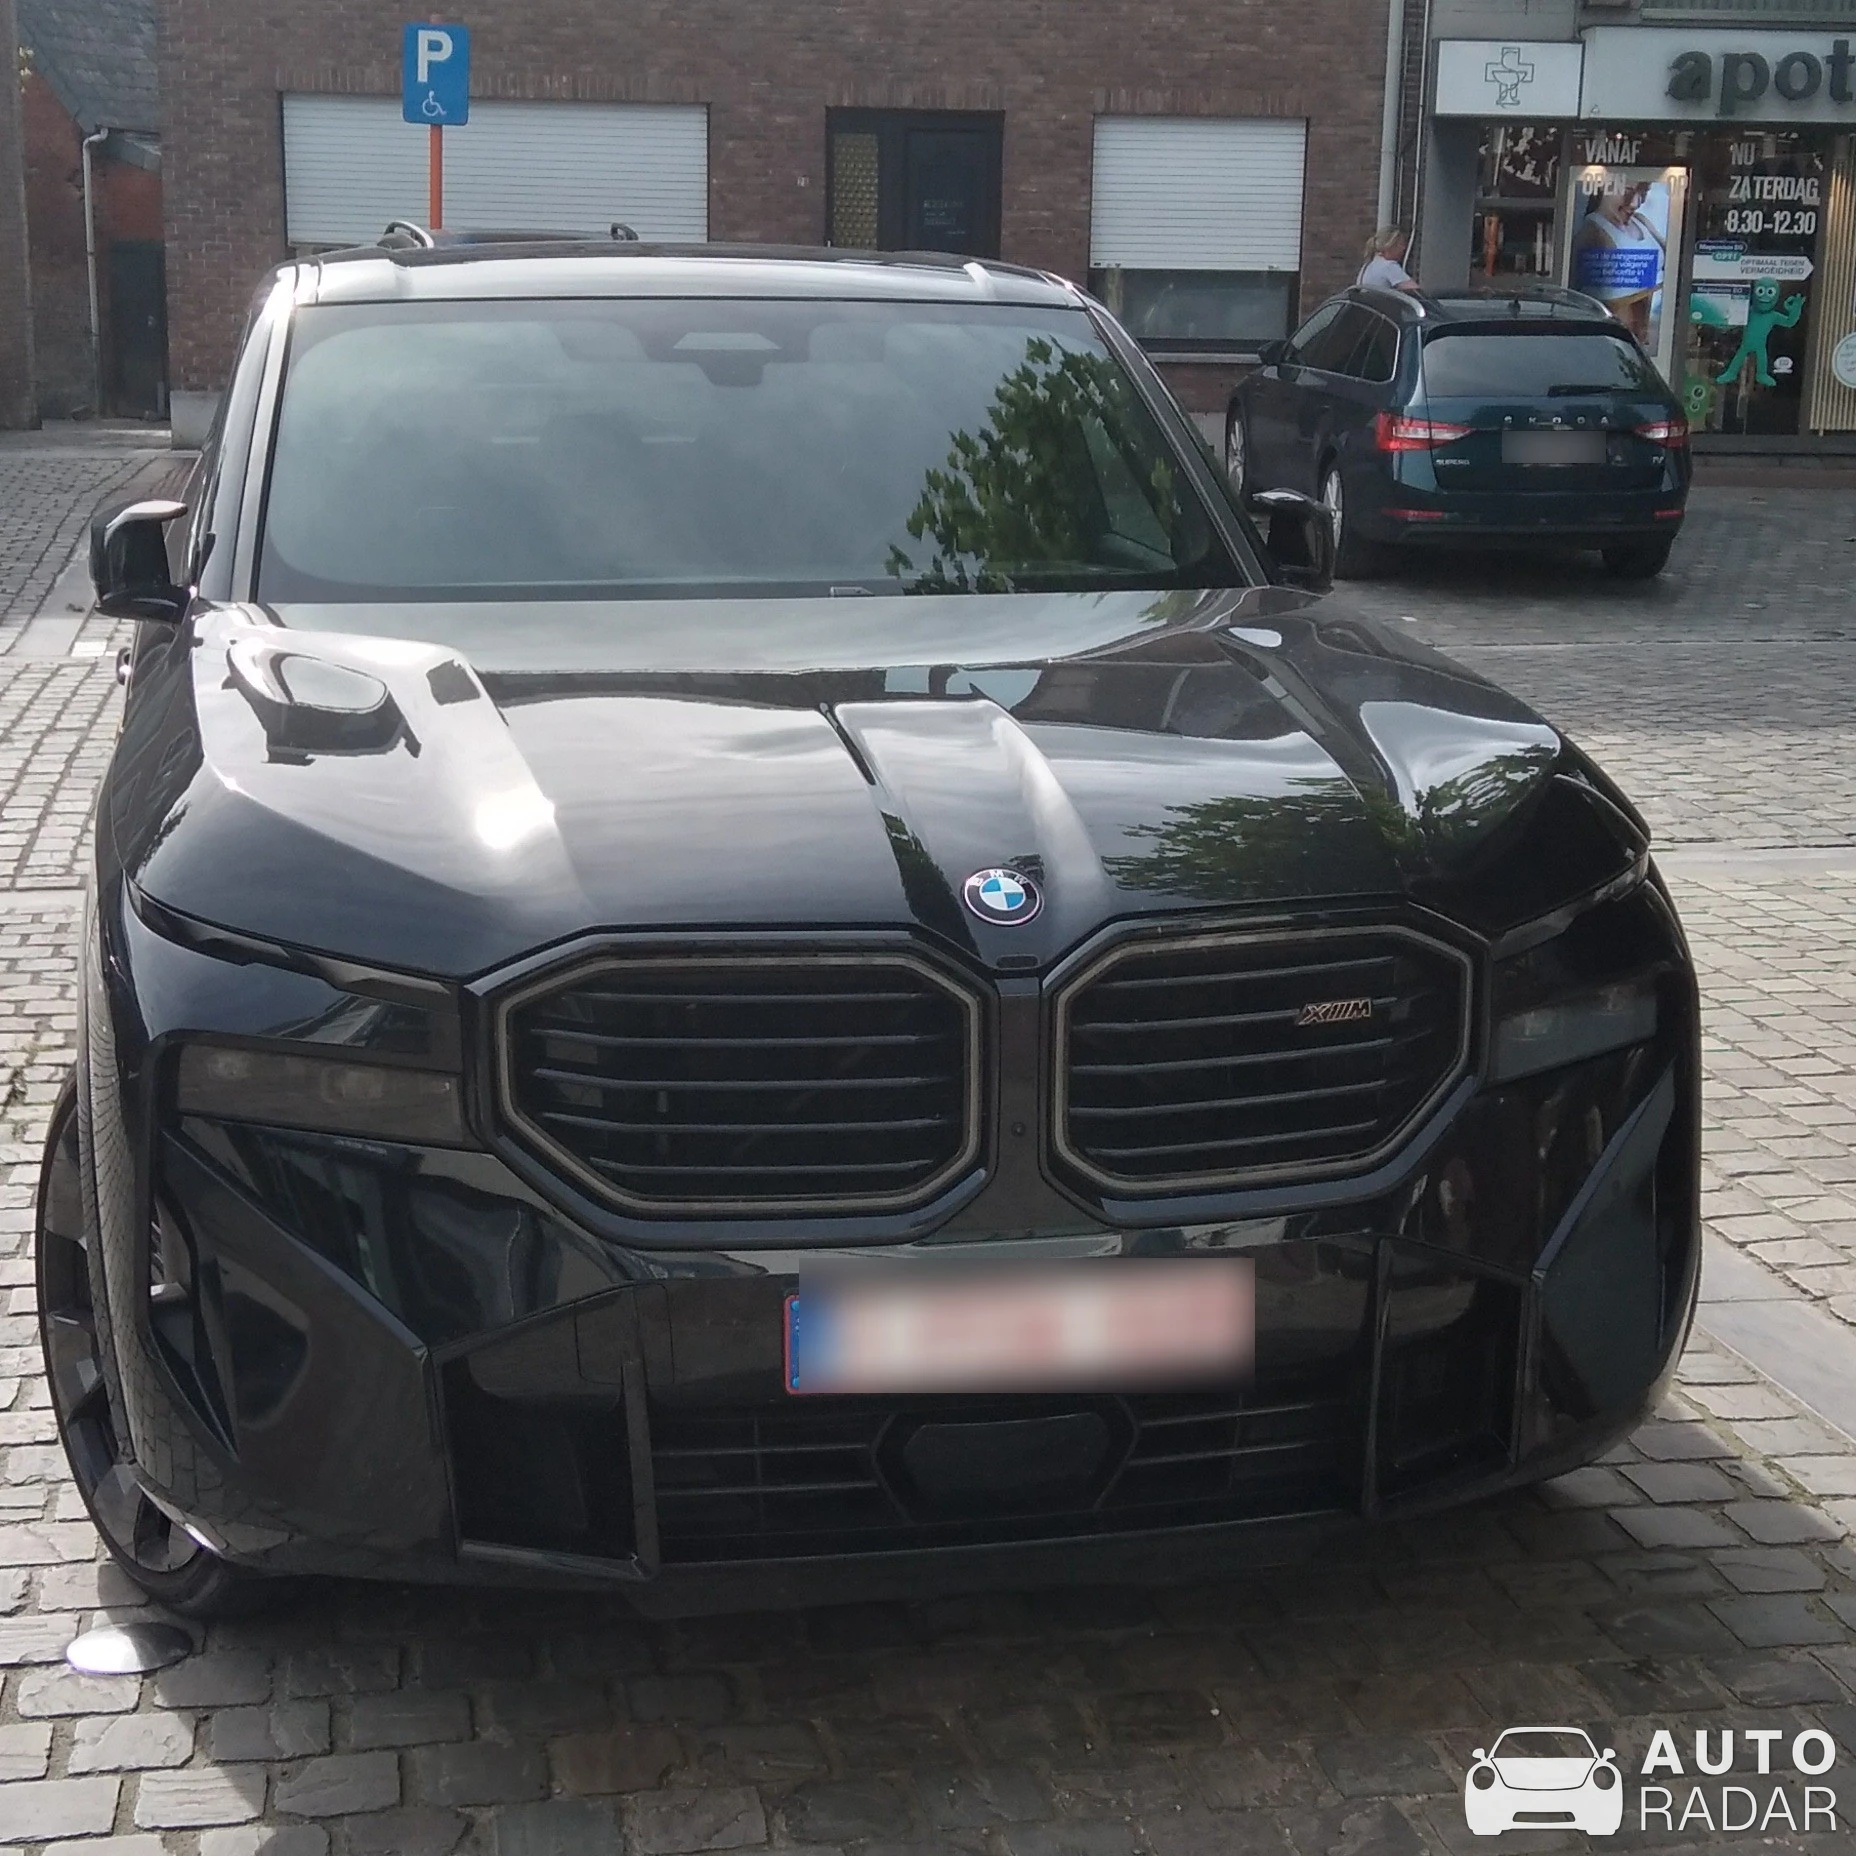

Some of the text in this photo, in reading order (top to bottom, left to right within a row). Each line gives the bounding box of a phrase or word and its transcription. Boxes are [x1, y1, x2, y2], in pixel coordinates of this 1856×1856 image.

[417, 30, 453, 82] P
[1666, 39, 1856, 118] apot
[1585, 140, 1756, 166] VANAF NU
[1582, 173, 1627, 196] OPEN
[1728, 176, 1820, 202] ZATERDAG
